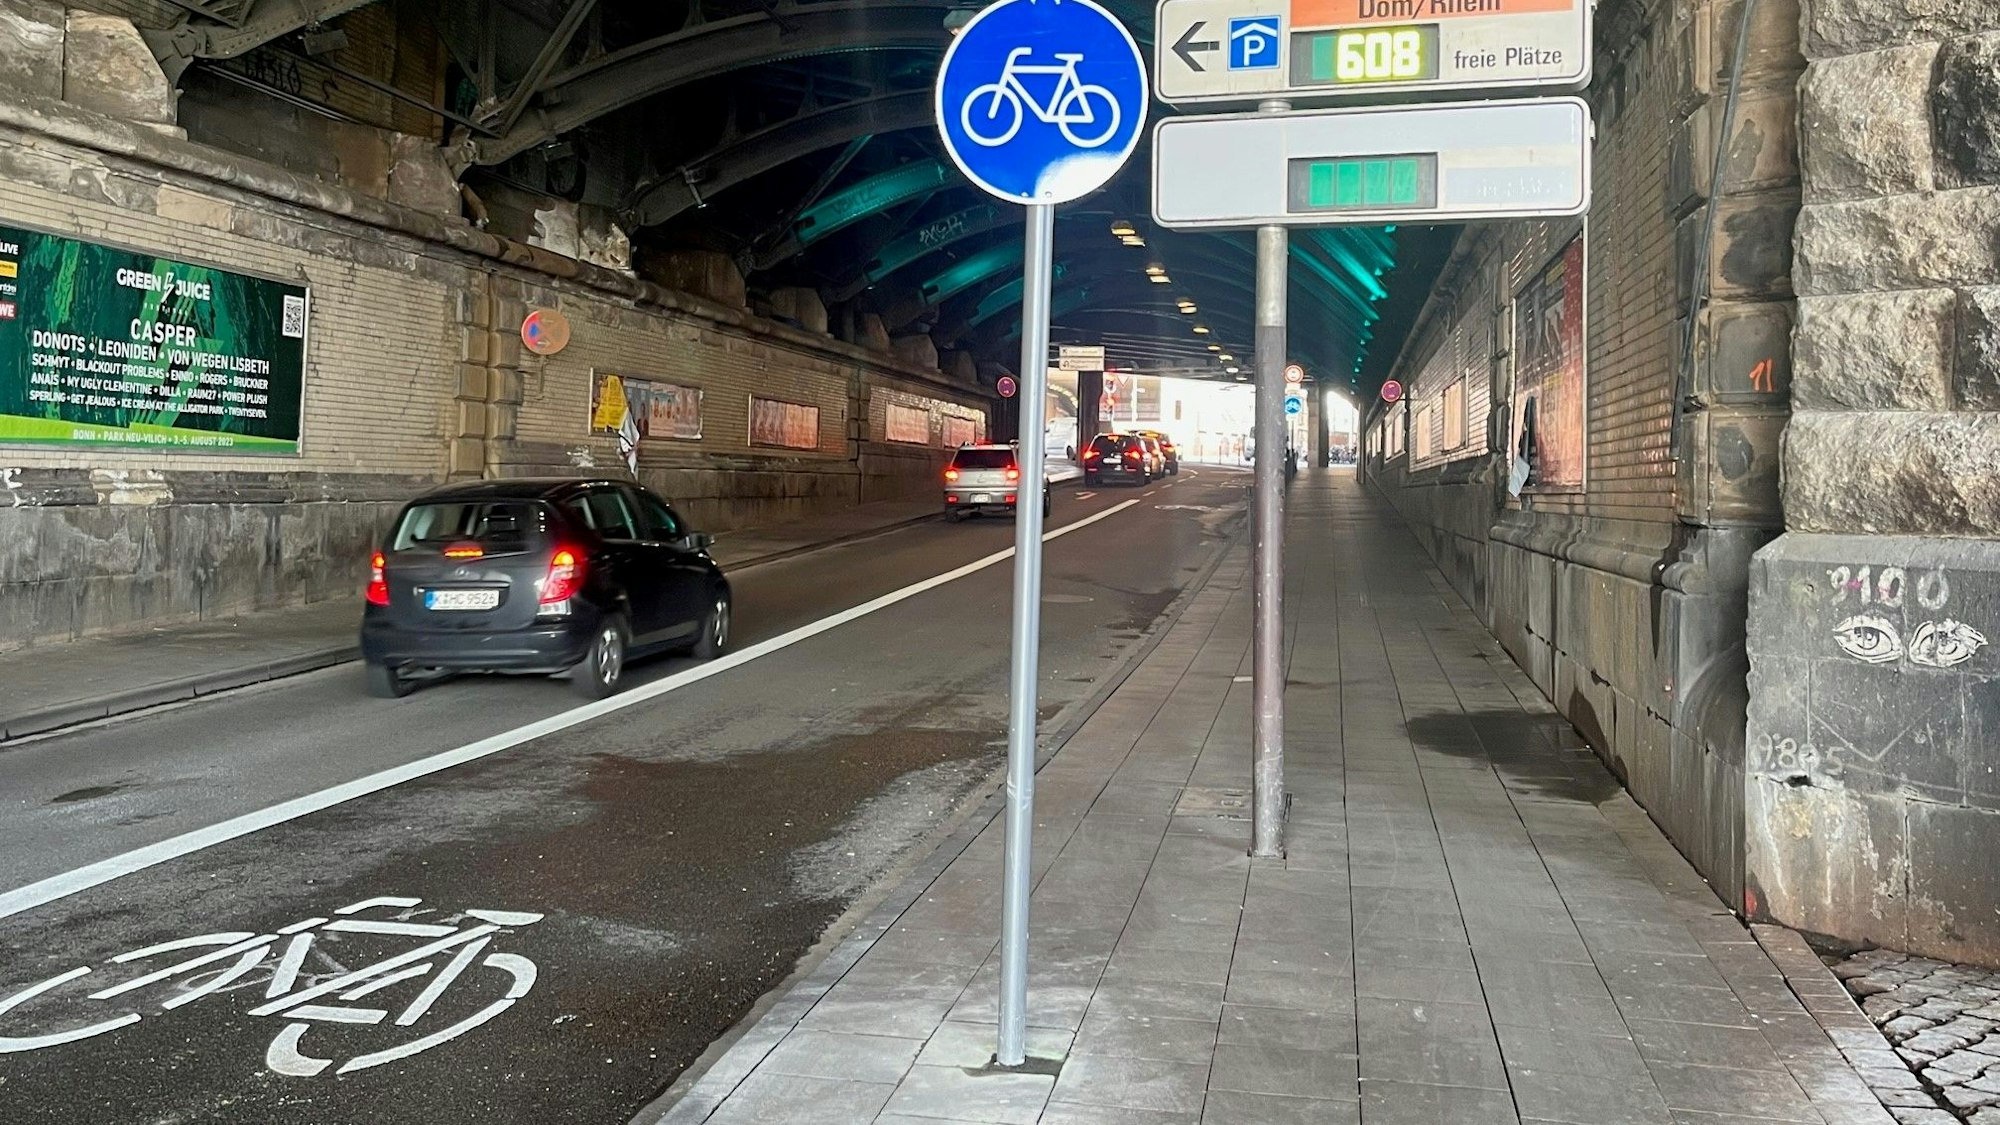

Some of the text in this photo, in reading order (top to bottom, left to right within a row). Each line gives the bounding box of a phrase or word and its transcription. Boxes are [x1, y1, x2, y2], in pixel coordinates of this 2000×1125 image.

[1337, 31, 1421, 79] 608
[1454, 47, 1562, 69] freie Plätze
[116, 268, 210, 300] GREEN JUICE
[130, 318, 196, 348] CASPER
[33, 330, 270, 375] DONOTS LEONIDEN VON WEGEN LISBETH
[32, 353, 269, 390] SCHMYT BLACKOUT PROBLEMS ENNIO ROGERS BRUCKNER
[29, 389, 66, 403] SPERLING
[70, 393, 85, 405] GET
[85, 395, 116, 407] JEALOUS
[121, 398, 133, 409] ICE
[133, 399, 155, 411] CREAM
[155, 401, 164, 411] AT
[163, 401, 177, 412] THE
[176, 402, 209, 414] ALLIGATOR
[208, 404, 225, 415] PARK
[66, 375, 81, 388] MY
[80, 376, 102, 390] UGLY
[102, 379, 153, 395] CLEMENTINE
[159, 385, 182, 398] DILLA
[187, 387, 216, 400] RAUM27
[222, 390, 246, 403] POWER
[246, 392, 268, 405] PLUSH
[73, 429, 96, 441] BONN
[103, 430, 125, 442] PARK
[125, 432, 168, 444] NEU-VILICH
[190, 435, 217, 447] AUGUST
[217, 436, 234, 447] 2023
